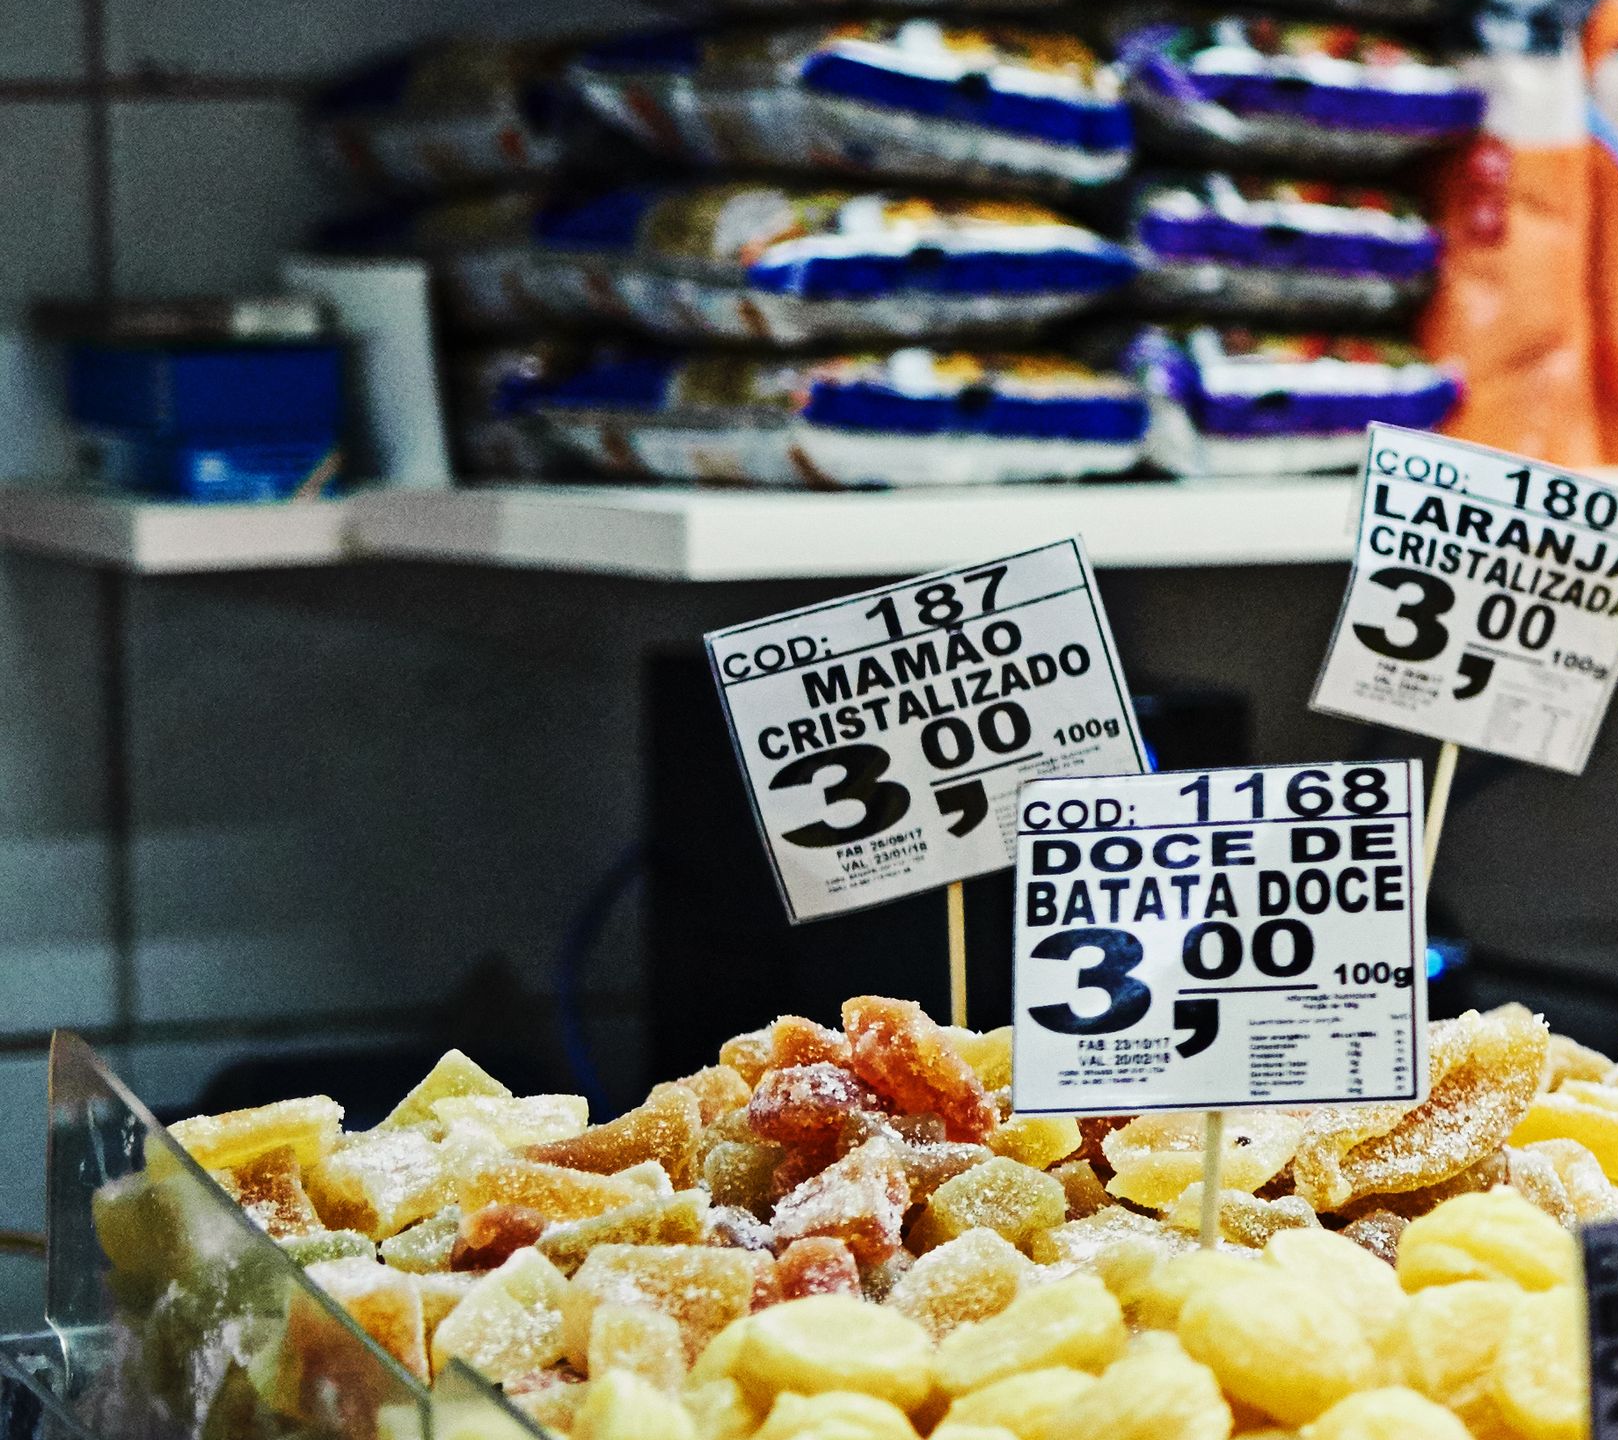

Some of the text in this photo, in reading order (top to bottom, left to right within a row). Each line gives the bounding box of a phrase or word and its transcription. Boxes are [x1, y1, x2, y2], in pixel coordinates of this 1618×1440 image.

[1375, 448, 1618, 532] COD: 180
[723, 566, 1009, 679] COD: 187
[801, 620, 1023, 709] MAMÃO
[757, 643, 1091, 761] CRISTALIZADO
[1053, 718, 1120, 747] 100g
[1023, 767, 1391, 830] COD: 1168
[1031, 824, 1397, 876] DOCE DE
[1026, 865, 1405, 928] BATATA DOCE
[1334, 962, 1414, 988] 100g
